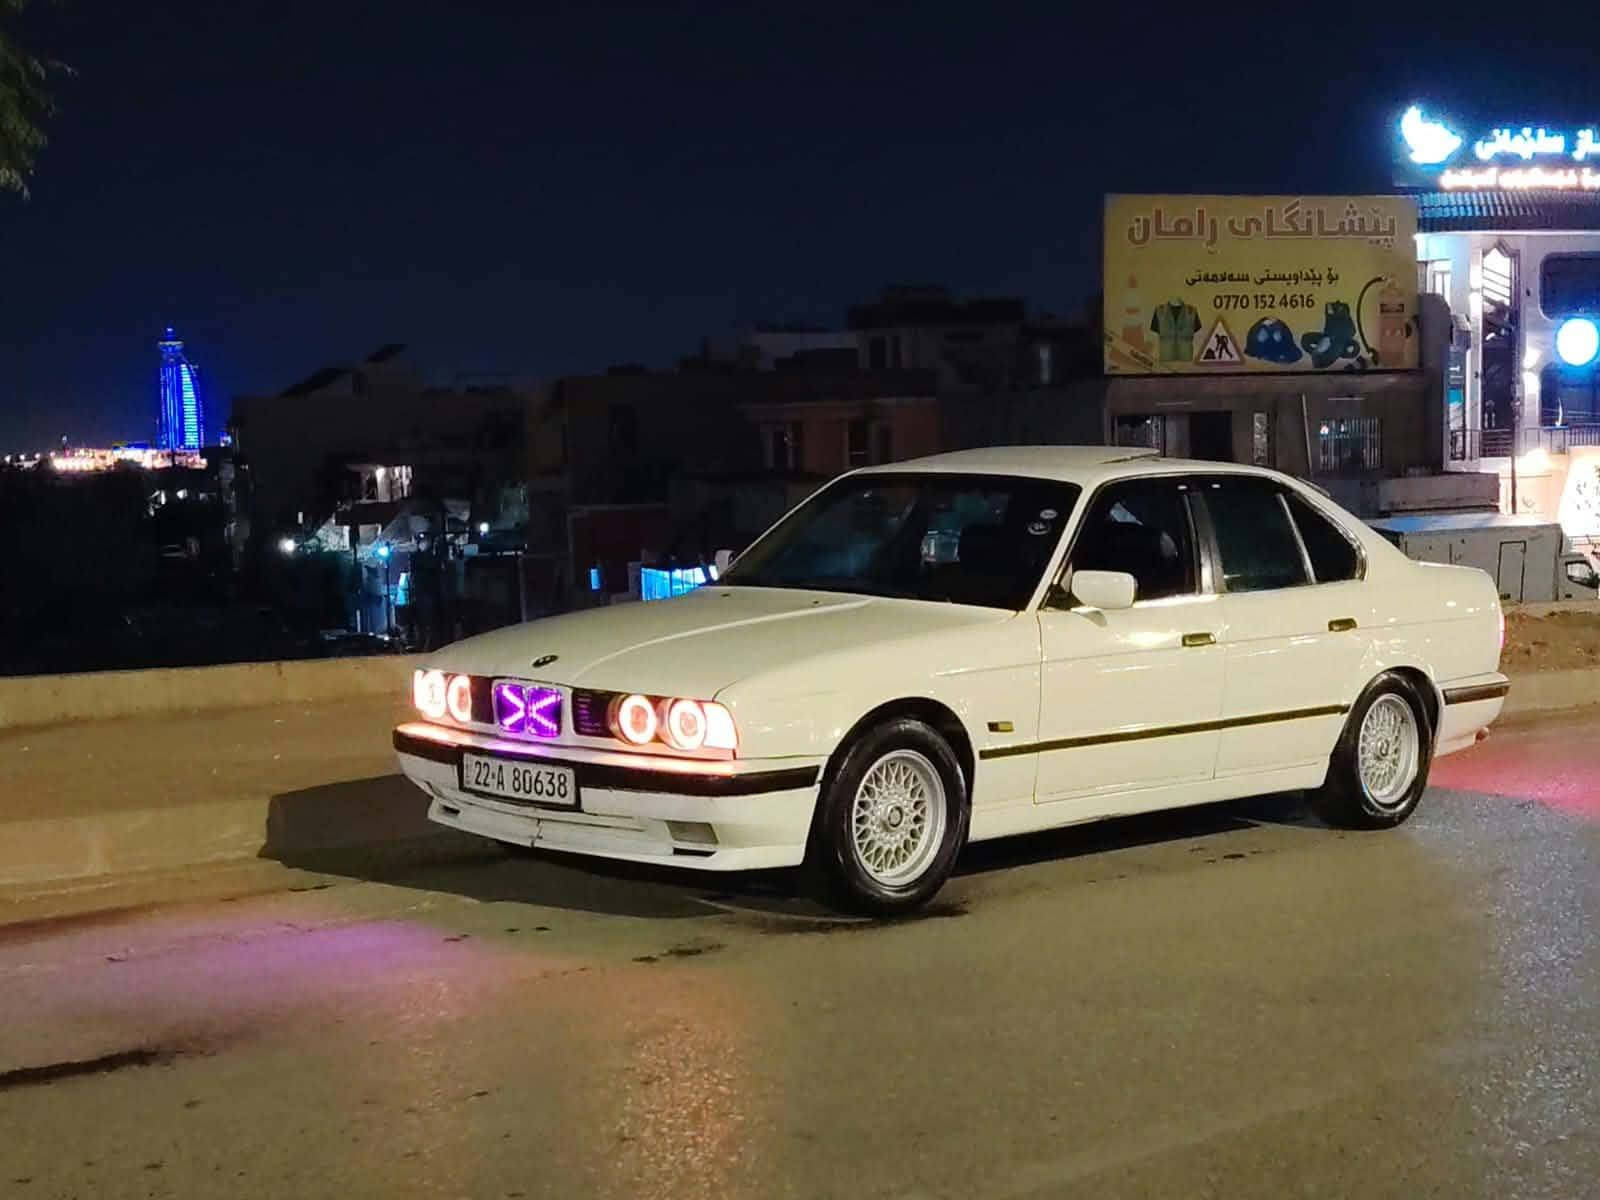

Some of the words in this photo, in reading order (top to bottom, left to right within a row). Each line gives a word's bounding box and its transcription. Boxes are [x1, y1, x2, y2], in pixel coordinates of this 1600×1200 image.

[1227, 200, 1396, 248] پێشانگای
[1213, 294, 1249, 310] 0770
[1253, 294, 1275, 309] 152
[1279, 293, 1315, 309] 4616
[512, 767, 568, 798] 80638
